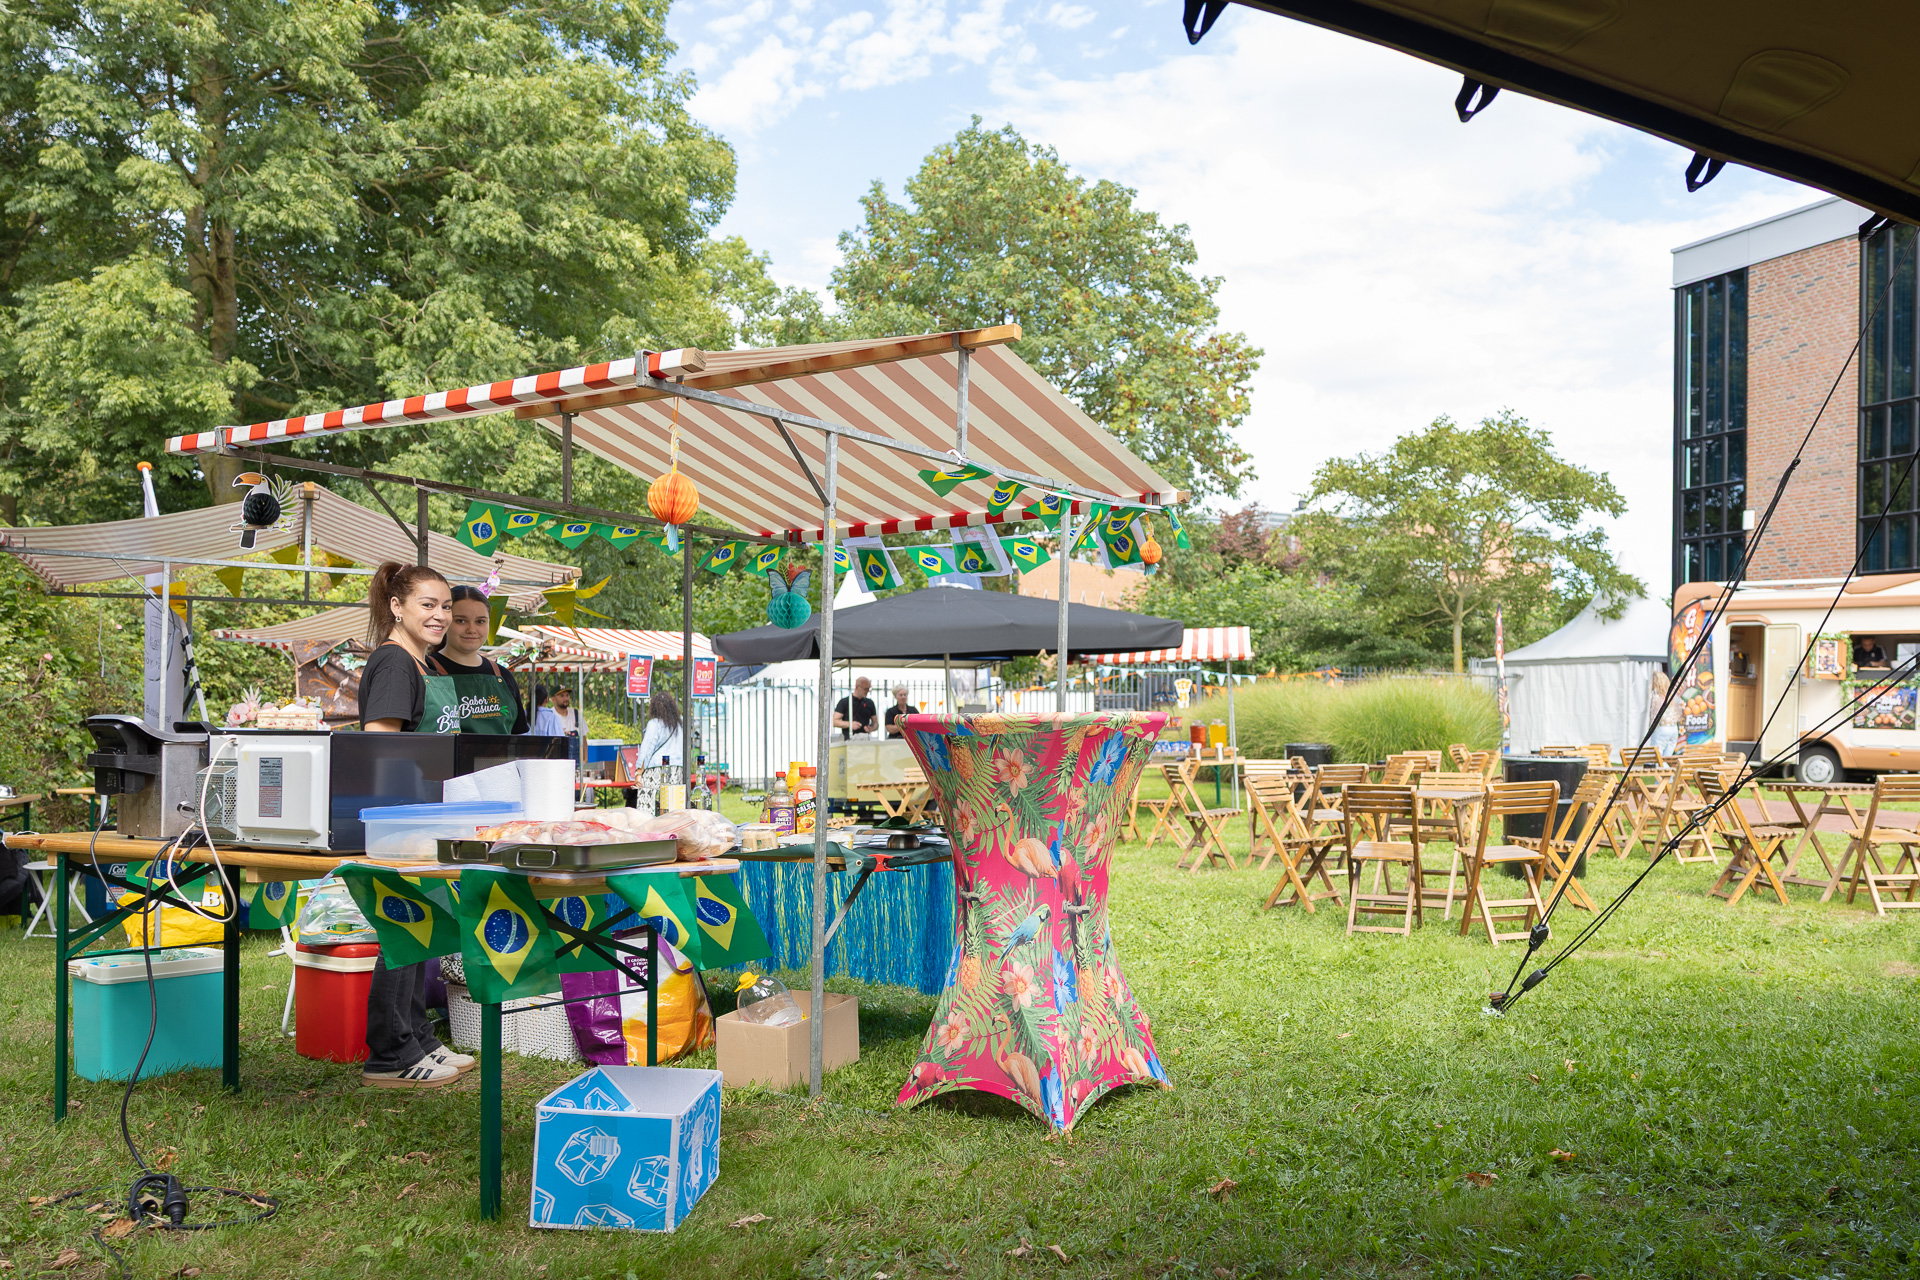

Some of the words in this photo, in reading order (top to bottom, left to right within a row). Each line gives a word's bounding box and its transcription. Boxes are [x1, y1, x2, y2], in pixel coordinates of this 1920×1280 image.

[461, 695, 489, 706] Sabor
[458, 703, 501, 719] Brasuca
[1685, 713, 1708, 726] Food
[796, 801, 816, 814] SALSA
[112, 865, 127, 874] Cole
